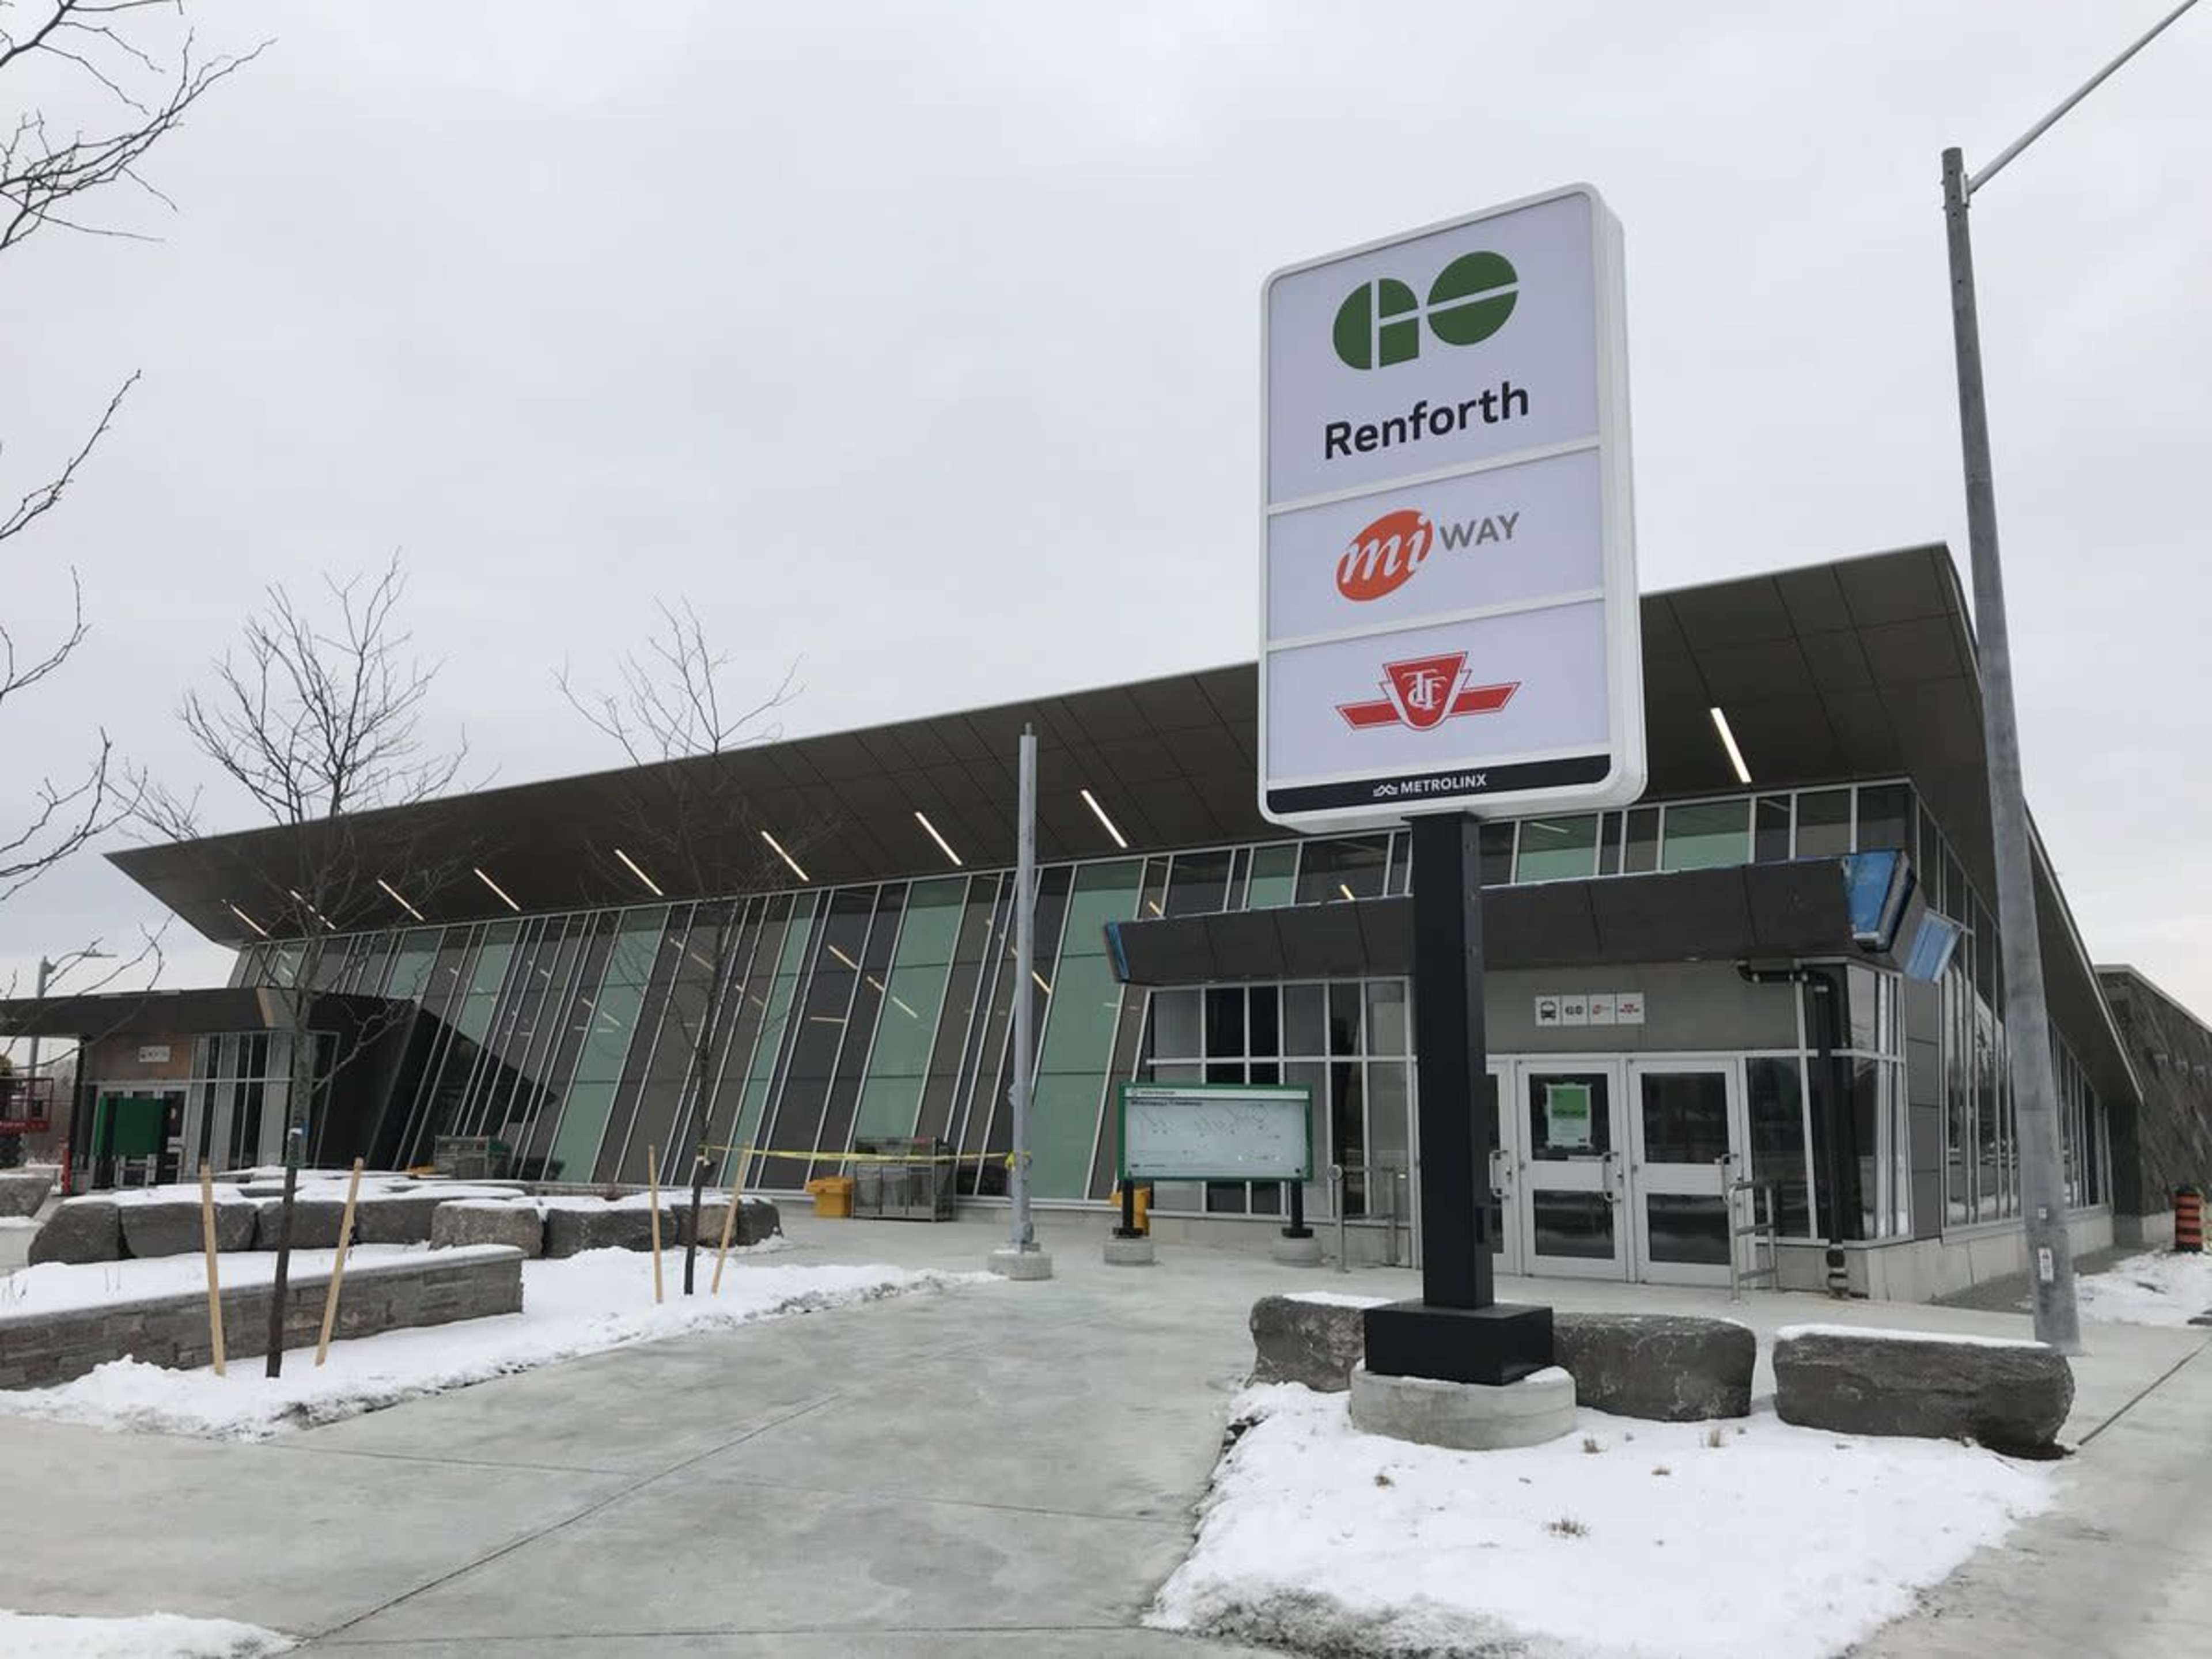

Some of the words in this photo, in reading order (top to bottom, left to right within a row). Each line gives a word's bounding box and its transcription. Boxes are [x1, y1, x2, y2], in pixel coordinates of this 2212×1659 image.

[1332, 250, 1519, 371] GO
[1324, 381, 1529, 460] Renforth
[1400, 773, 1487, 794] METROLINX
